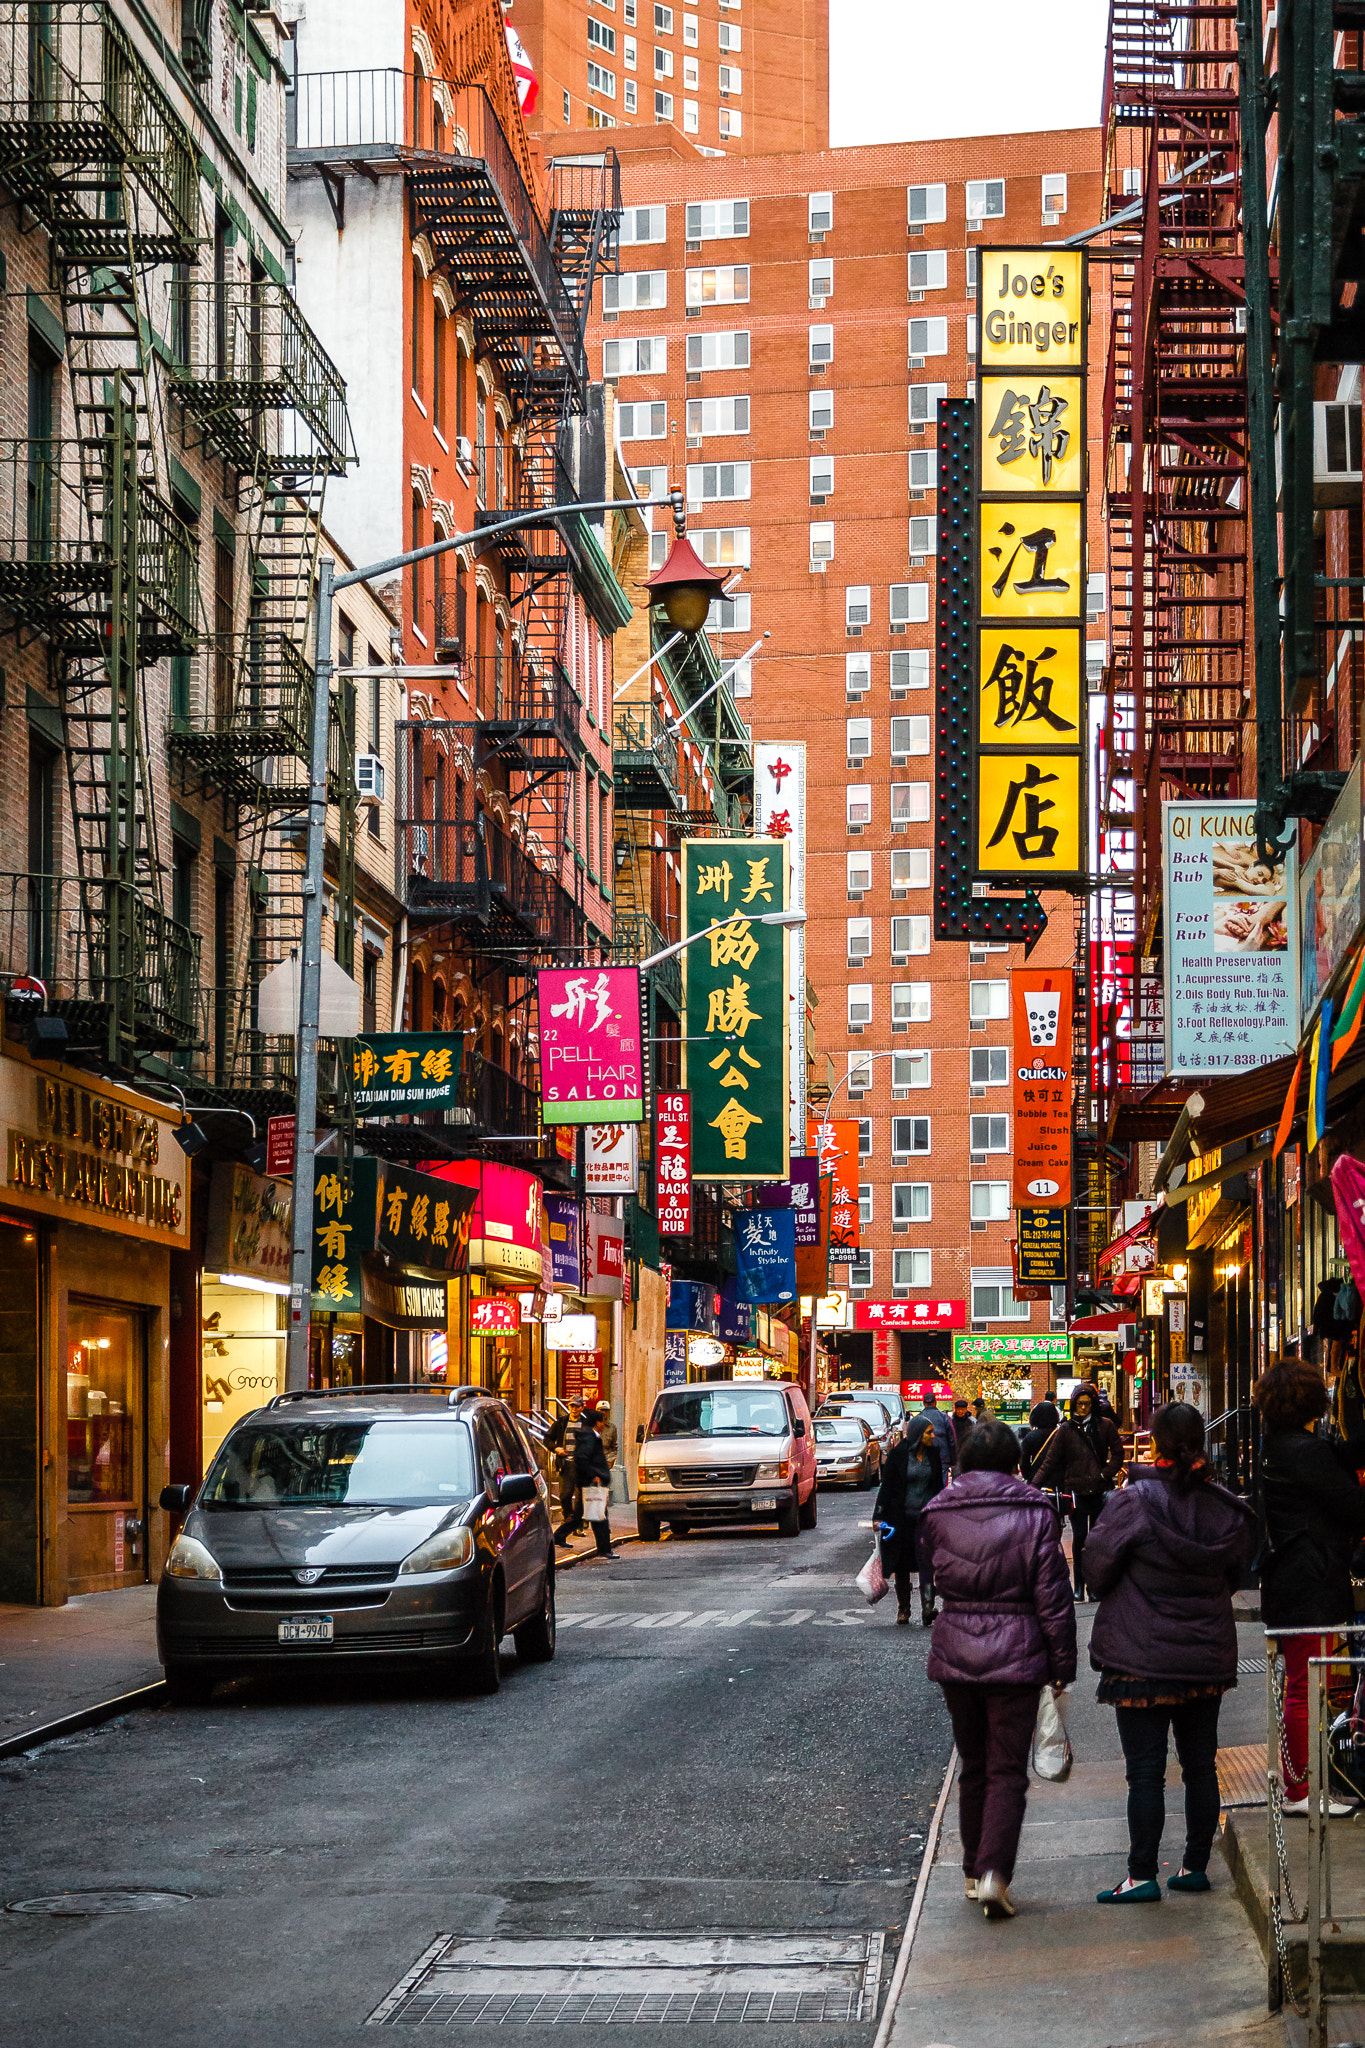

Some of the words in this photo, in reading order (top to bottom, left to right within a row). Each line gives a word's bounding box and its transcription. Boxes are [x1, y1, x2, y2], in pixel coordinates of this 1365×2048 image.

[998, 264, 1064, 298] Joe's
[985, 310, 1078, 352] Ginger
[981, 384, 1078, 861] 錦江飯店
[1172, 816, 1192, 840] QI
[1200, 815, 1256, 838] KUNG
[1172, 852, 1208, 864] Back
[1172, 870, 1203, 883] Rub
[1176, 912, 1210, 923] Foot
[1176, 930, 1206, 940] Rub
[1182, 956, 1213, 968] Health
[1216, 956, 1282, 967] Preservation
[1176, 974, 1254, 985] 1.Acupressure.
[1175, 989, 1204, 1000] 2.Oils
[1206, 988, 1230, 1000] Body
[1234, 988, 1289, 999] Rub.Tui-Na.
[1177, 1017, 1206, 1028] 3.Foot
[1210, 1016, 1288, 1028] Reflexology.Pain.
[543, 1030, 558, 1041] 22
[704, 907, 763, 1160] 協勝公會
[550, 1046, 602, 1071] PELL
[1208, 1054, 1290, 1066] 917-838-01
[587, 1064, 637, 1081] HAIR
[1017, 1066, 1068, 1081] Quickly
[390, 1090, 405, 1102] DIM
[406, 1088, 424, 1100] SUM
[426, 1084, 450, 1098] HOUSE
[548, 1083, 637, 1100] SALON
[1023, 1089, 1064, 1102] 快可立
[664, 1096, 684, 1112] 16
[658, 1113, 676, 1122] PELL
[678, 1113, 688, 1122] ST.
[1018, 1110, 1047, 1118] Bubble
[1053, 1110, 1068, 1118] Tea
[278, 1122, 295, 1130] STANDIN
[1040, 1126, 1069, 1134] Slush
[658, 1183, 689, 1194] BACK
[1036, 1183, 1050, 1194] 11
[669, 1196, 678, 1207] &
[658, 1208, 689, 1219] FOOT
[662, 1220, 685, 1232] RUB
[750, 1248, 778, 1256] Infinity
[406, 1286, 422, 1316] SUM
[421, 1288, 444, 1317] HOUSE
